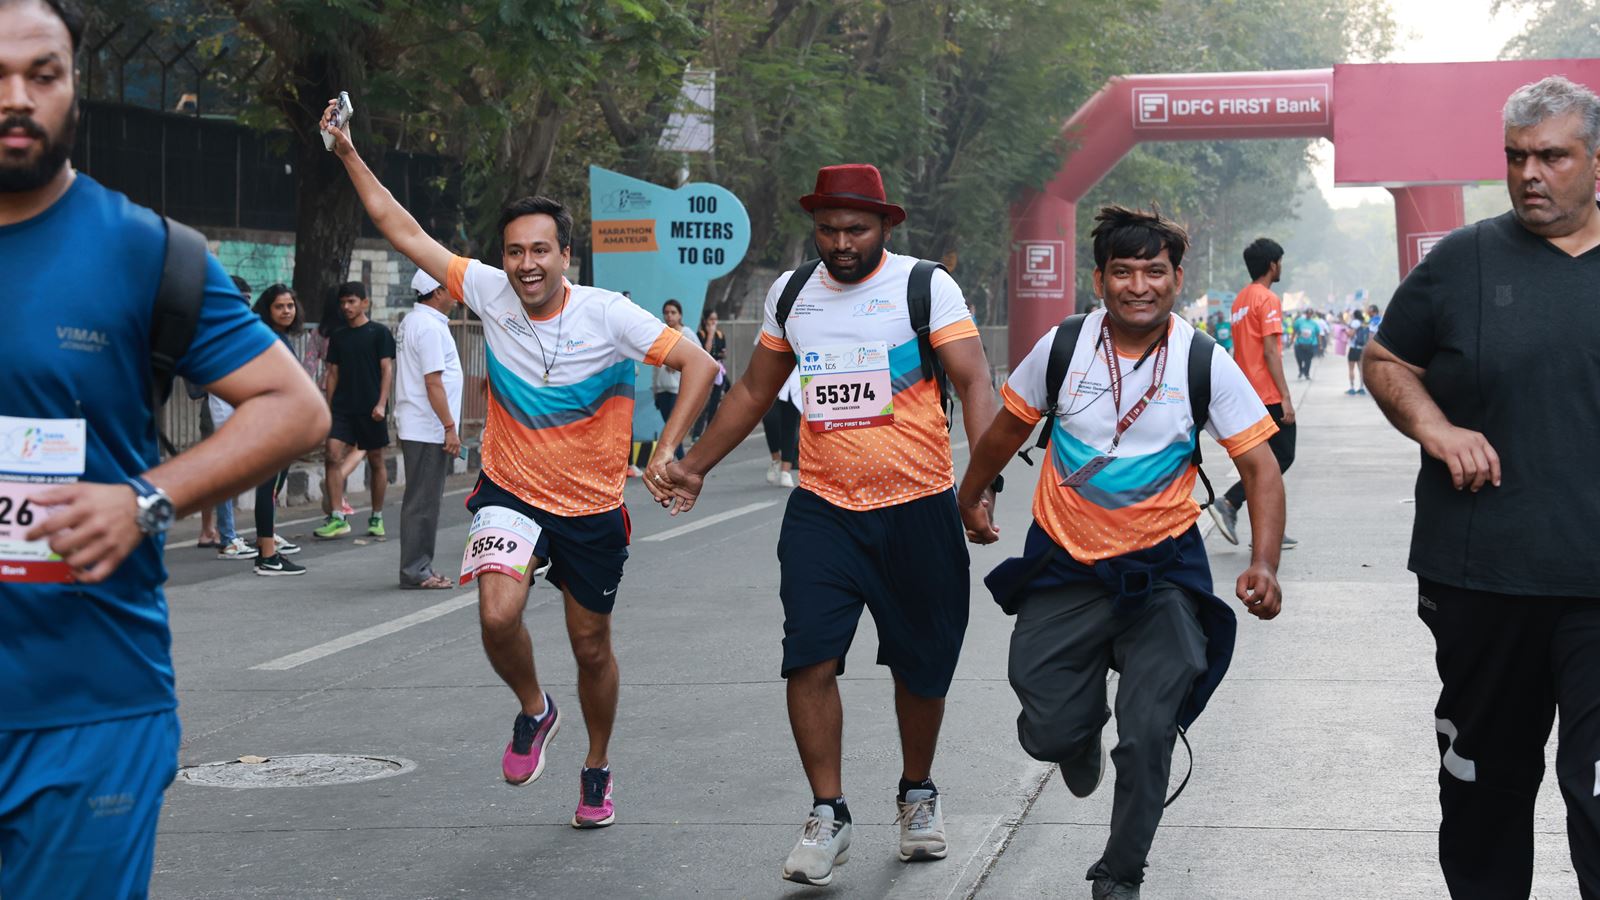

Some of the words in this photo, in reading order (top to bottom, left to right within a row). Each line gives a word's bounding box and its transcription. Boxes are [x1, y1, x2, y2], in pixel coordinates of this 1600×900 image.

[1172, 99, 1214, 115] IDFC
[1219, 98, 1271, 114] FIRST
[1276, 96, 1321, 113] Bank
[687, 196, 717, 214] 100
[598, 227, 652, 235] MARATHON
[603, 235, 649, 243] AMATEUR
[671, 221, 733, 239] METERS
[678, 247, 698, 264] TO
[703, 247, 725, 265] GO
[56, 325, 110, 346] VIMAL
[1105, 339, 1116, 369] MARATHON
[815, 382, 876, 405] 55374
[0, 496, 34, 527] 26
[471, 536, 518, 558] 55549
[1, 565, 27, 575] Bank
